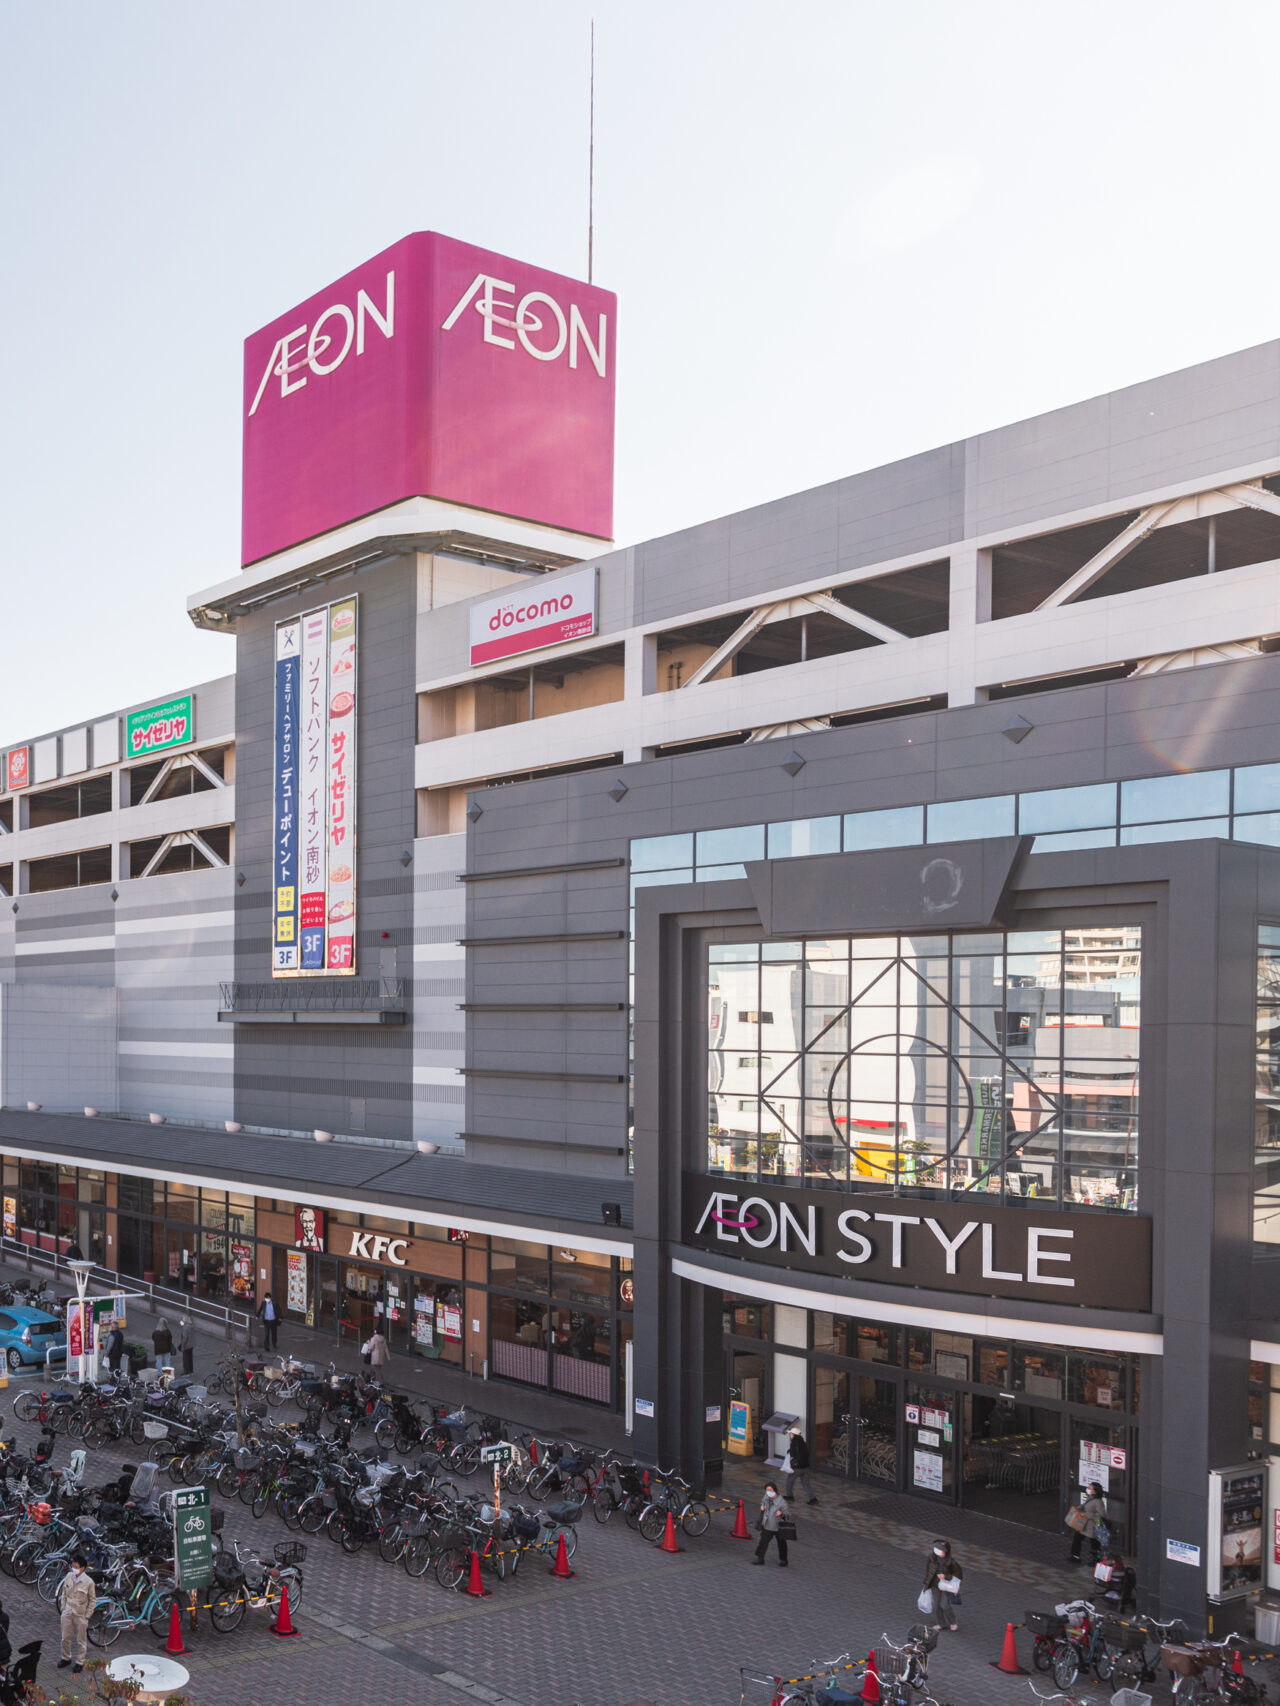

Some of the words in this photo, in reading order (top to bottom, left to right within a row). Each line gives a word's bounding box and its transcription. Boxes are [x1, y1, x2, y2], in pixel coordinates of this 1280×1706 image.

[489, 594, 574, 631] docomo
[131, 717, 186, 751] サイゼリヤ
[283, 663, 293, 764] ファミリーヘアサロン
[308, 657, 321, 773] ソフトバンク
[330, 731, 346, 847] サイゼリヤ
[280, 767, 294, 881] デューポイント
[306, 787, 321, 885] イオン南砂
[279, 951, 292, 964] 3F
[304, 934, 321, 952] 3F
[330, 944, 351, 964] 3F
[348, 1232, 407, 1265] KFC
[836, 1209, 1075, 1287] STYLE
